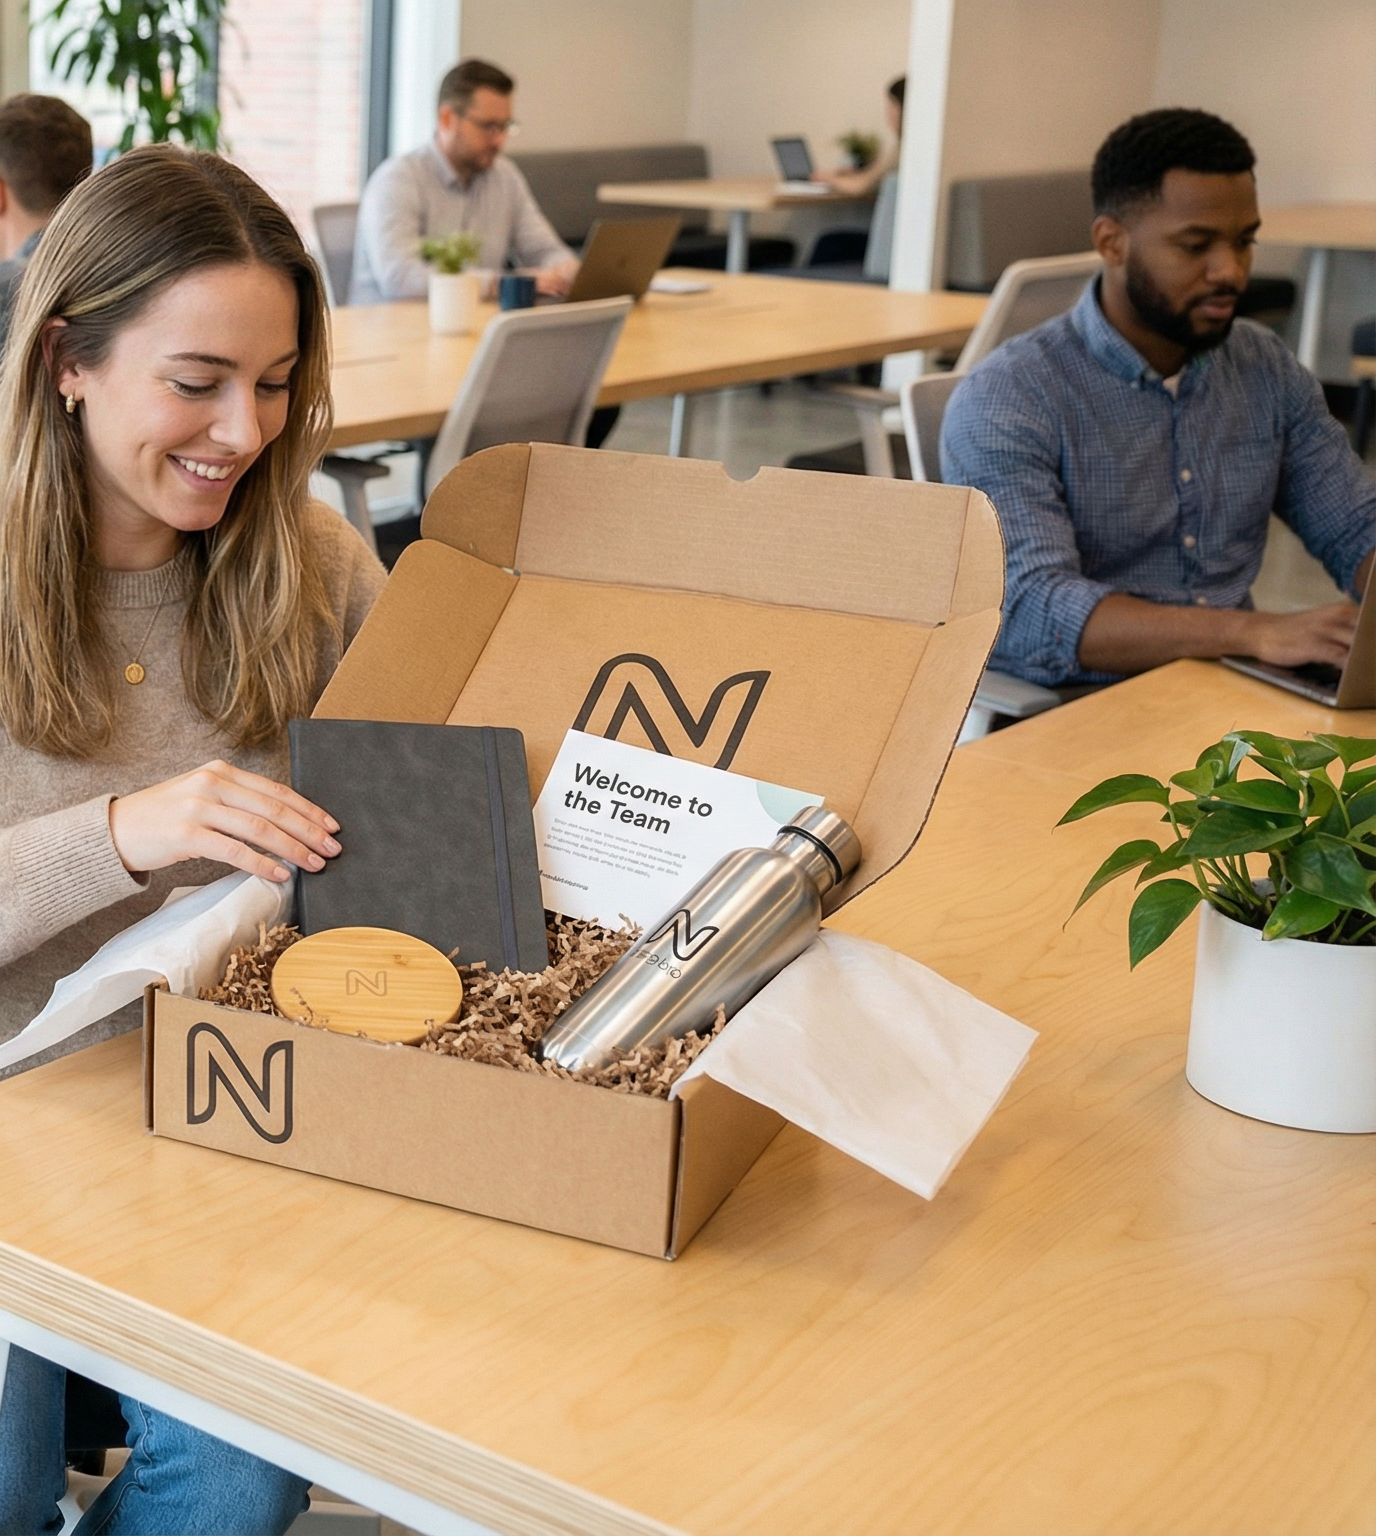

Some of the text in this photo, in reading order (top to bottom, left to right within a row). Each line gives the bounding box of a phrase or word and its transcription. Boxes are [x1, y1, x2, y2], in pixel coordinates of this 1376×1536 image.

[564, 790, 671, 834] the Team
[575, 763, 713, 817] Welcome to
[645, 909, 720, 961] N
[346, 969, 388, 996] N
[187, 1022, 294, 1144] N
